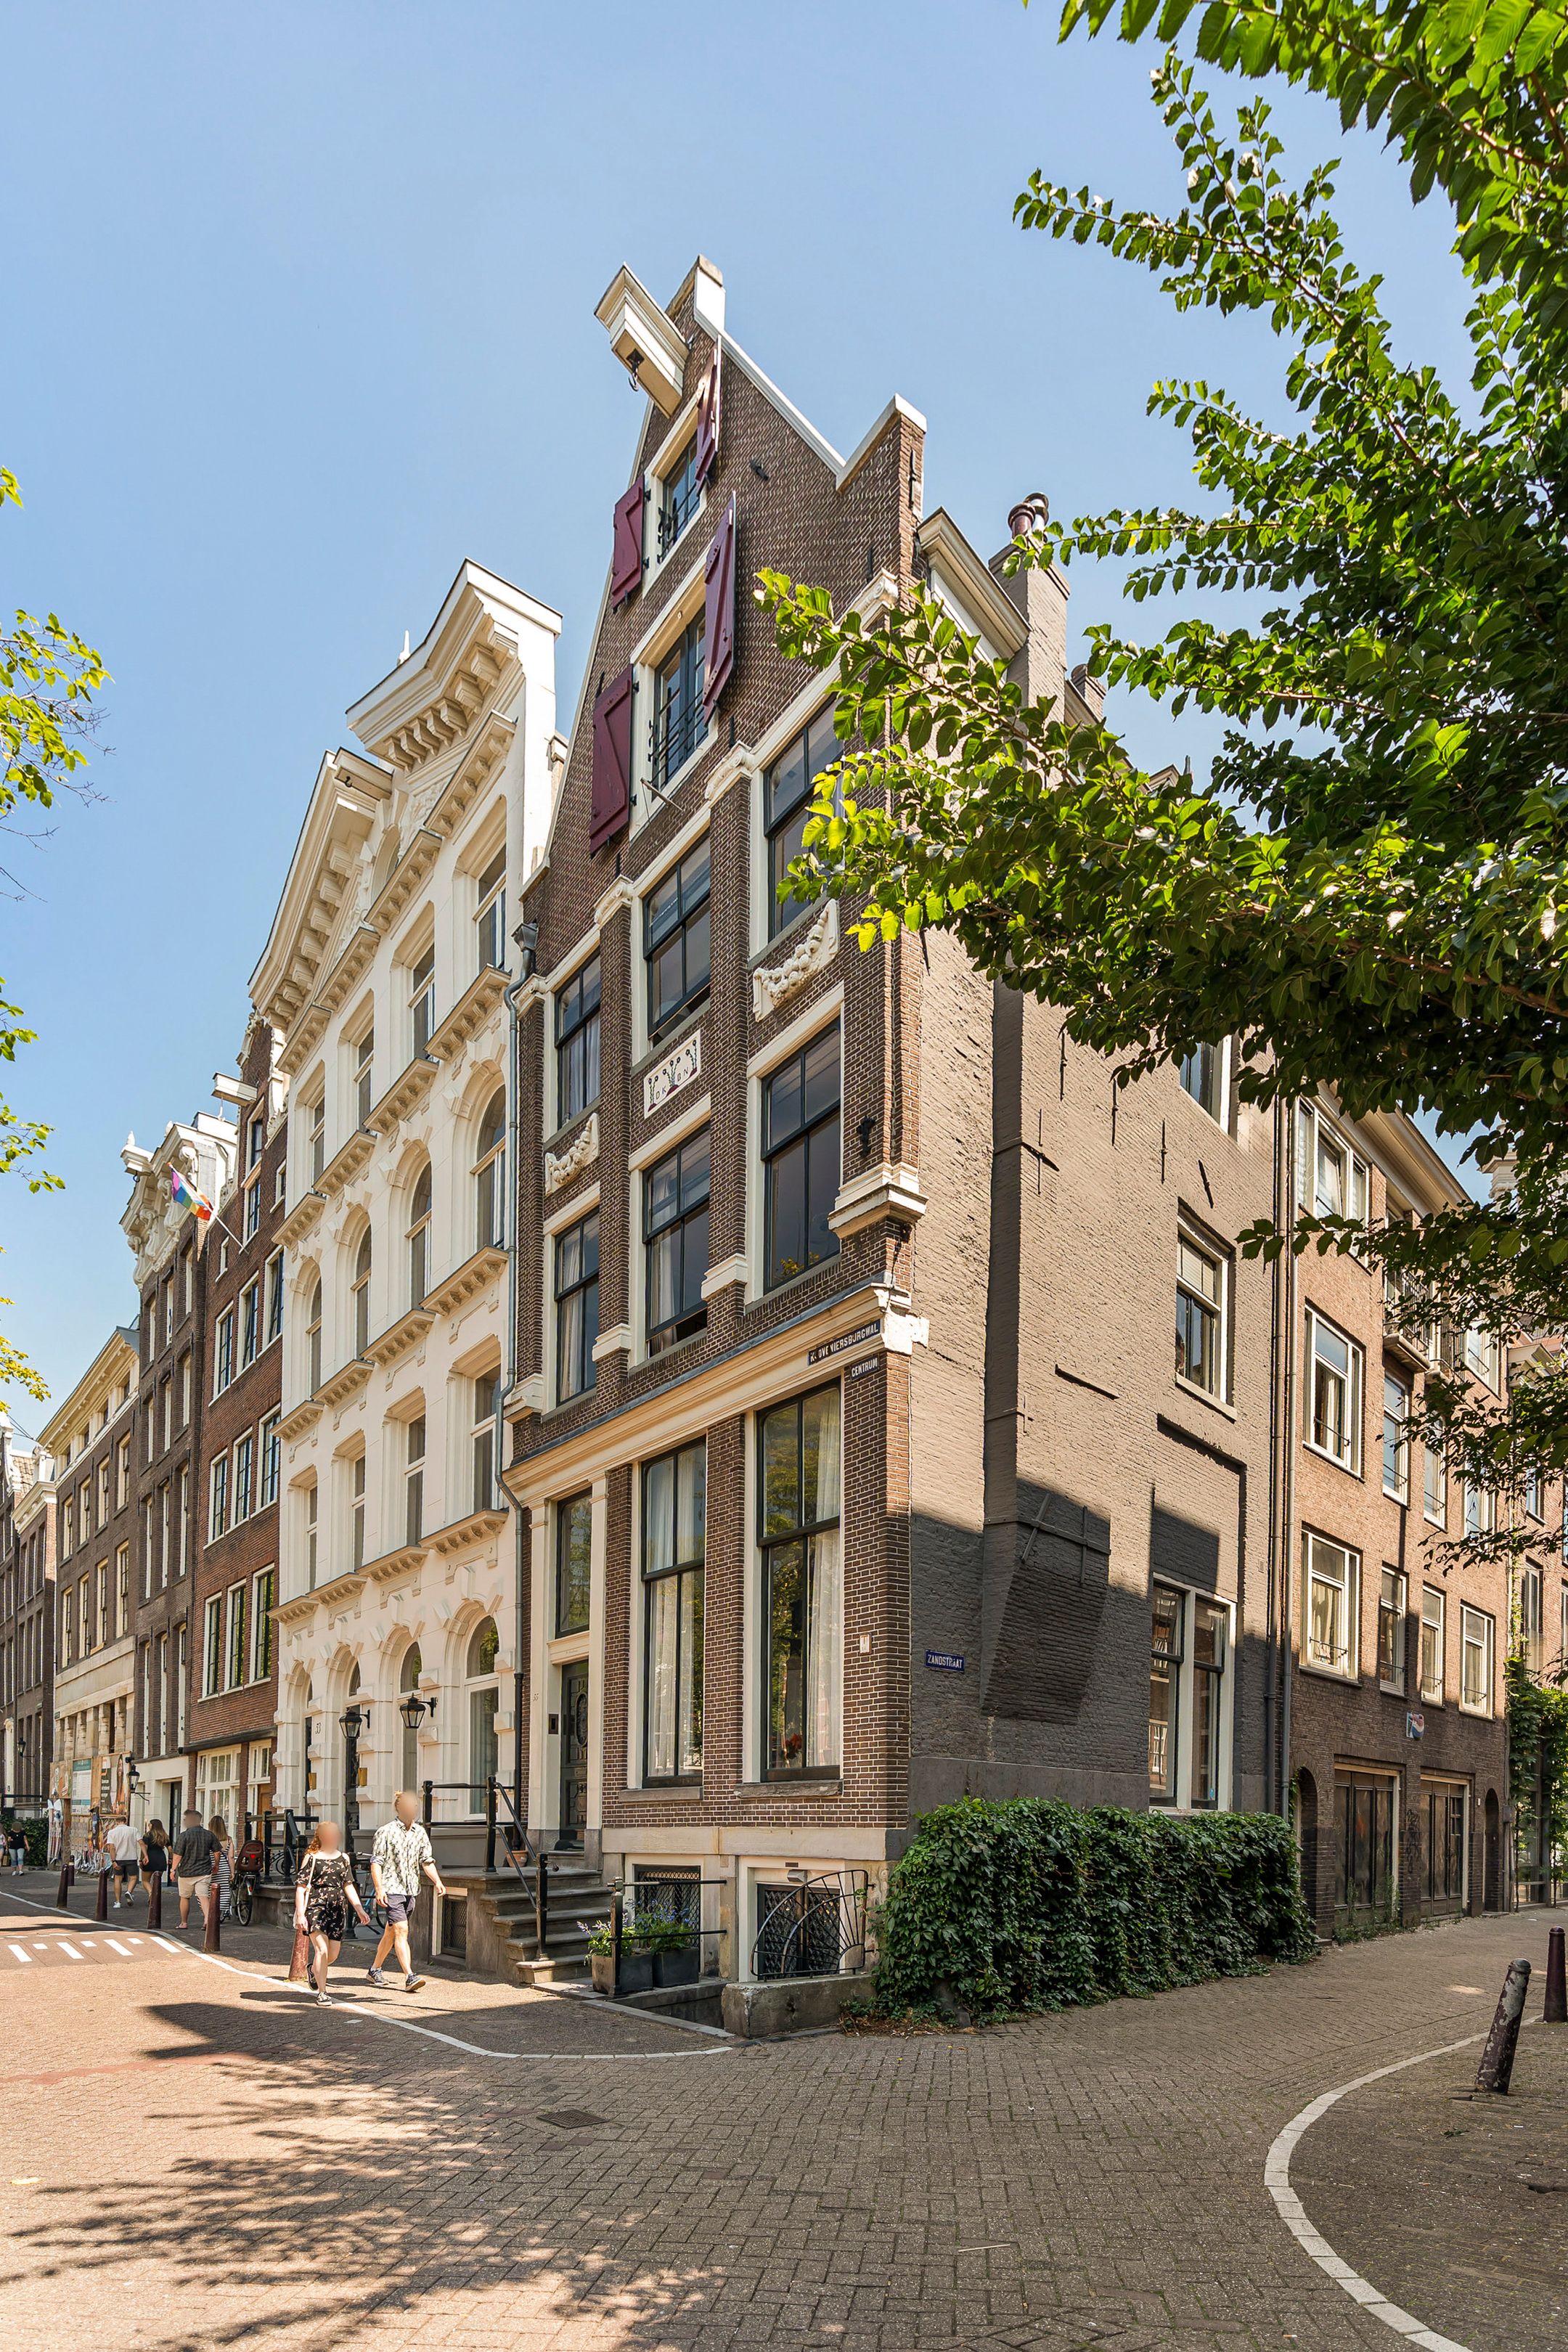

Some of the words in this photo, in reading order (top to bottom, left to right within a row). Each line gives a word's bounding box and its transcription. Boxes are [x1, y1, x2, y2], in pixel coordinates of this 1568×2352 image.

[810, 1323, 878, 1363] KOVENIERSBURGWAL
[851, 1357, 878, 1377] CENTRUM
[928, 1654, 963, 1668] ZANDSTRAAT
